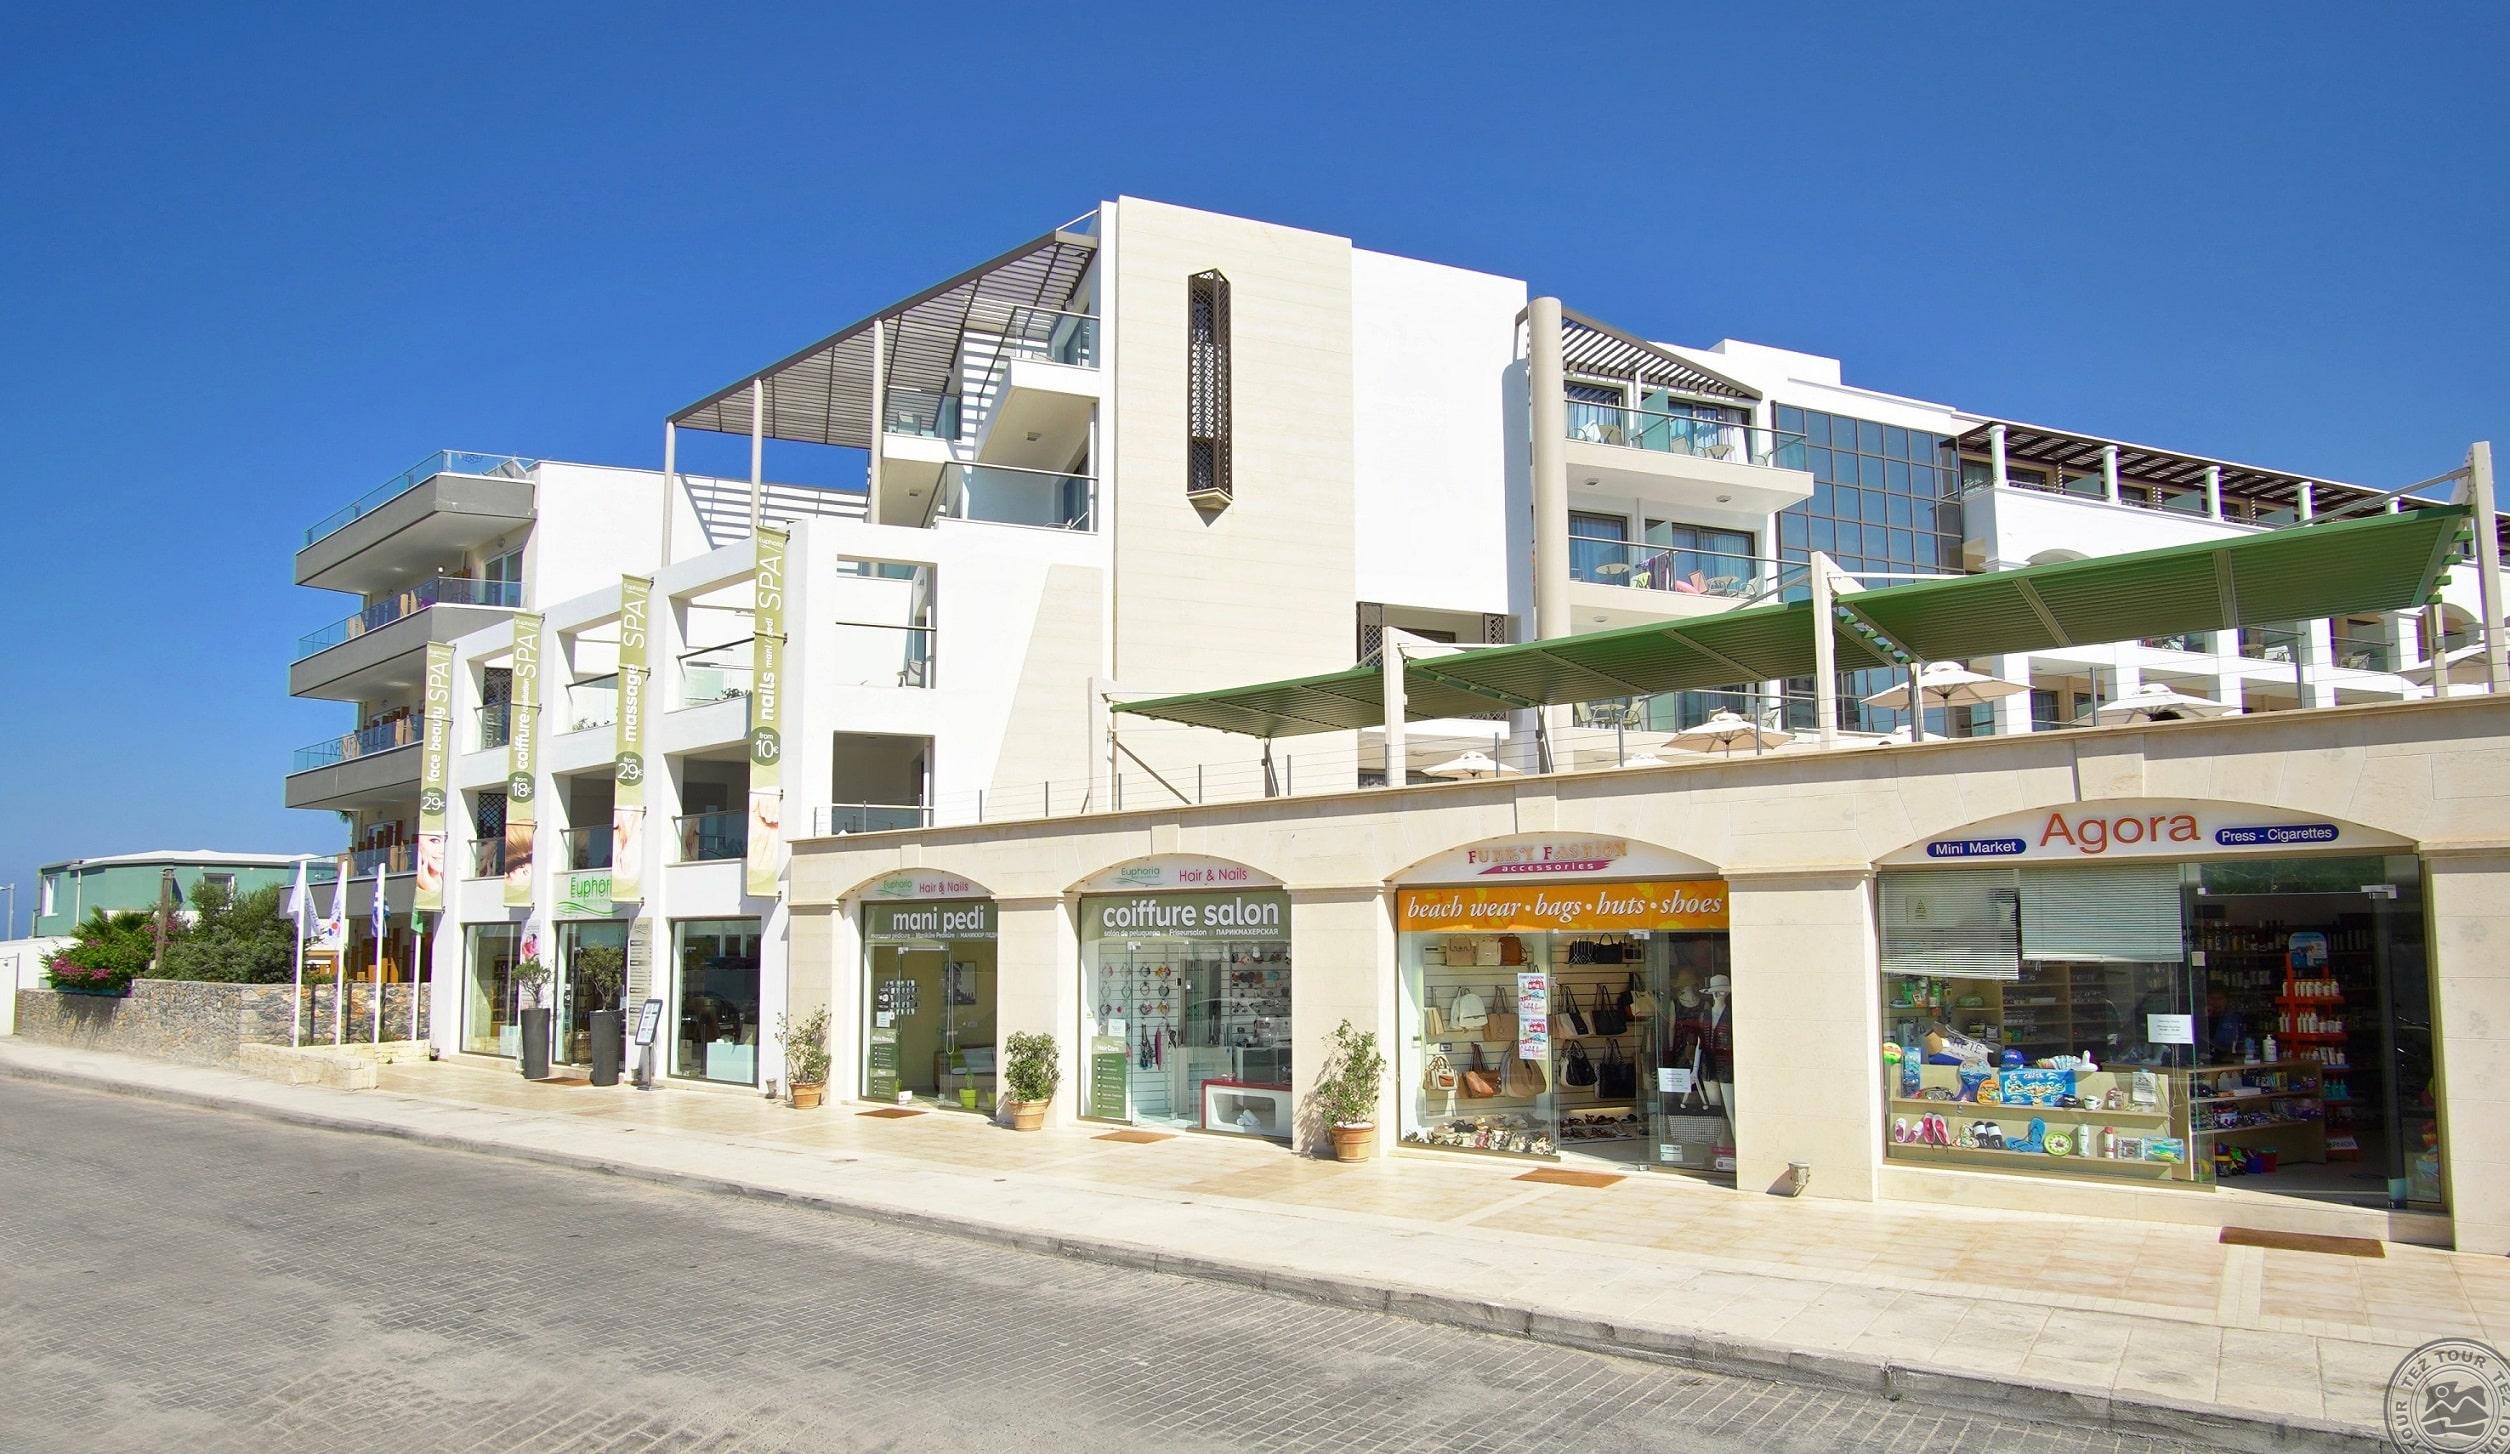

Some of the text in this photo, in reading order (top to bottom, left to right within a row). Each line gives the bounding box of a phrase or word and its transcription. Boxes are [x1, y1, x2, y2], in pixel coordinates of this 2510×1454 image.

[759, 555, 782, 611] SPA
[623, 599, 646, 649] SPA
[516, 633, 537, 678] SPA
[429, 662, 449, 703] SPA
[760, 672, 776, 721] nails
[625, 663, 642, 743] massage
[427, 706, 446, 782] face beauty
[517, 713, 531, 770] coiffure
[755, 740, 780, 758] 10€
[759, 732, 774, 740] from
[1936, 841, 2017, 855] Mini Market
[2039, 813, 2201, 854] Agora
[2222, 831, 2256, 842] Press
[2267, 828, 2333, 842] Cigarettes
[1121, 866, 1160, 878] Euphoria
[1179, 867, 1248, 882] Hair & Nails
[1502, 863, 1594, 872] accessories
[919, 880, 969, 894] Hair & Nails
[893, 905, 985, 933] mani pedi
[1102, 896, 1279, 928] coiffure salon
[1407, 895, 1463, 918] beach
[1470, 901, 1521, 917] wear
[1535, 893, 1582, 923] bags
[1660, 889, 1722, 914] shoes
